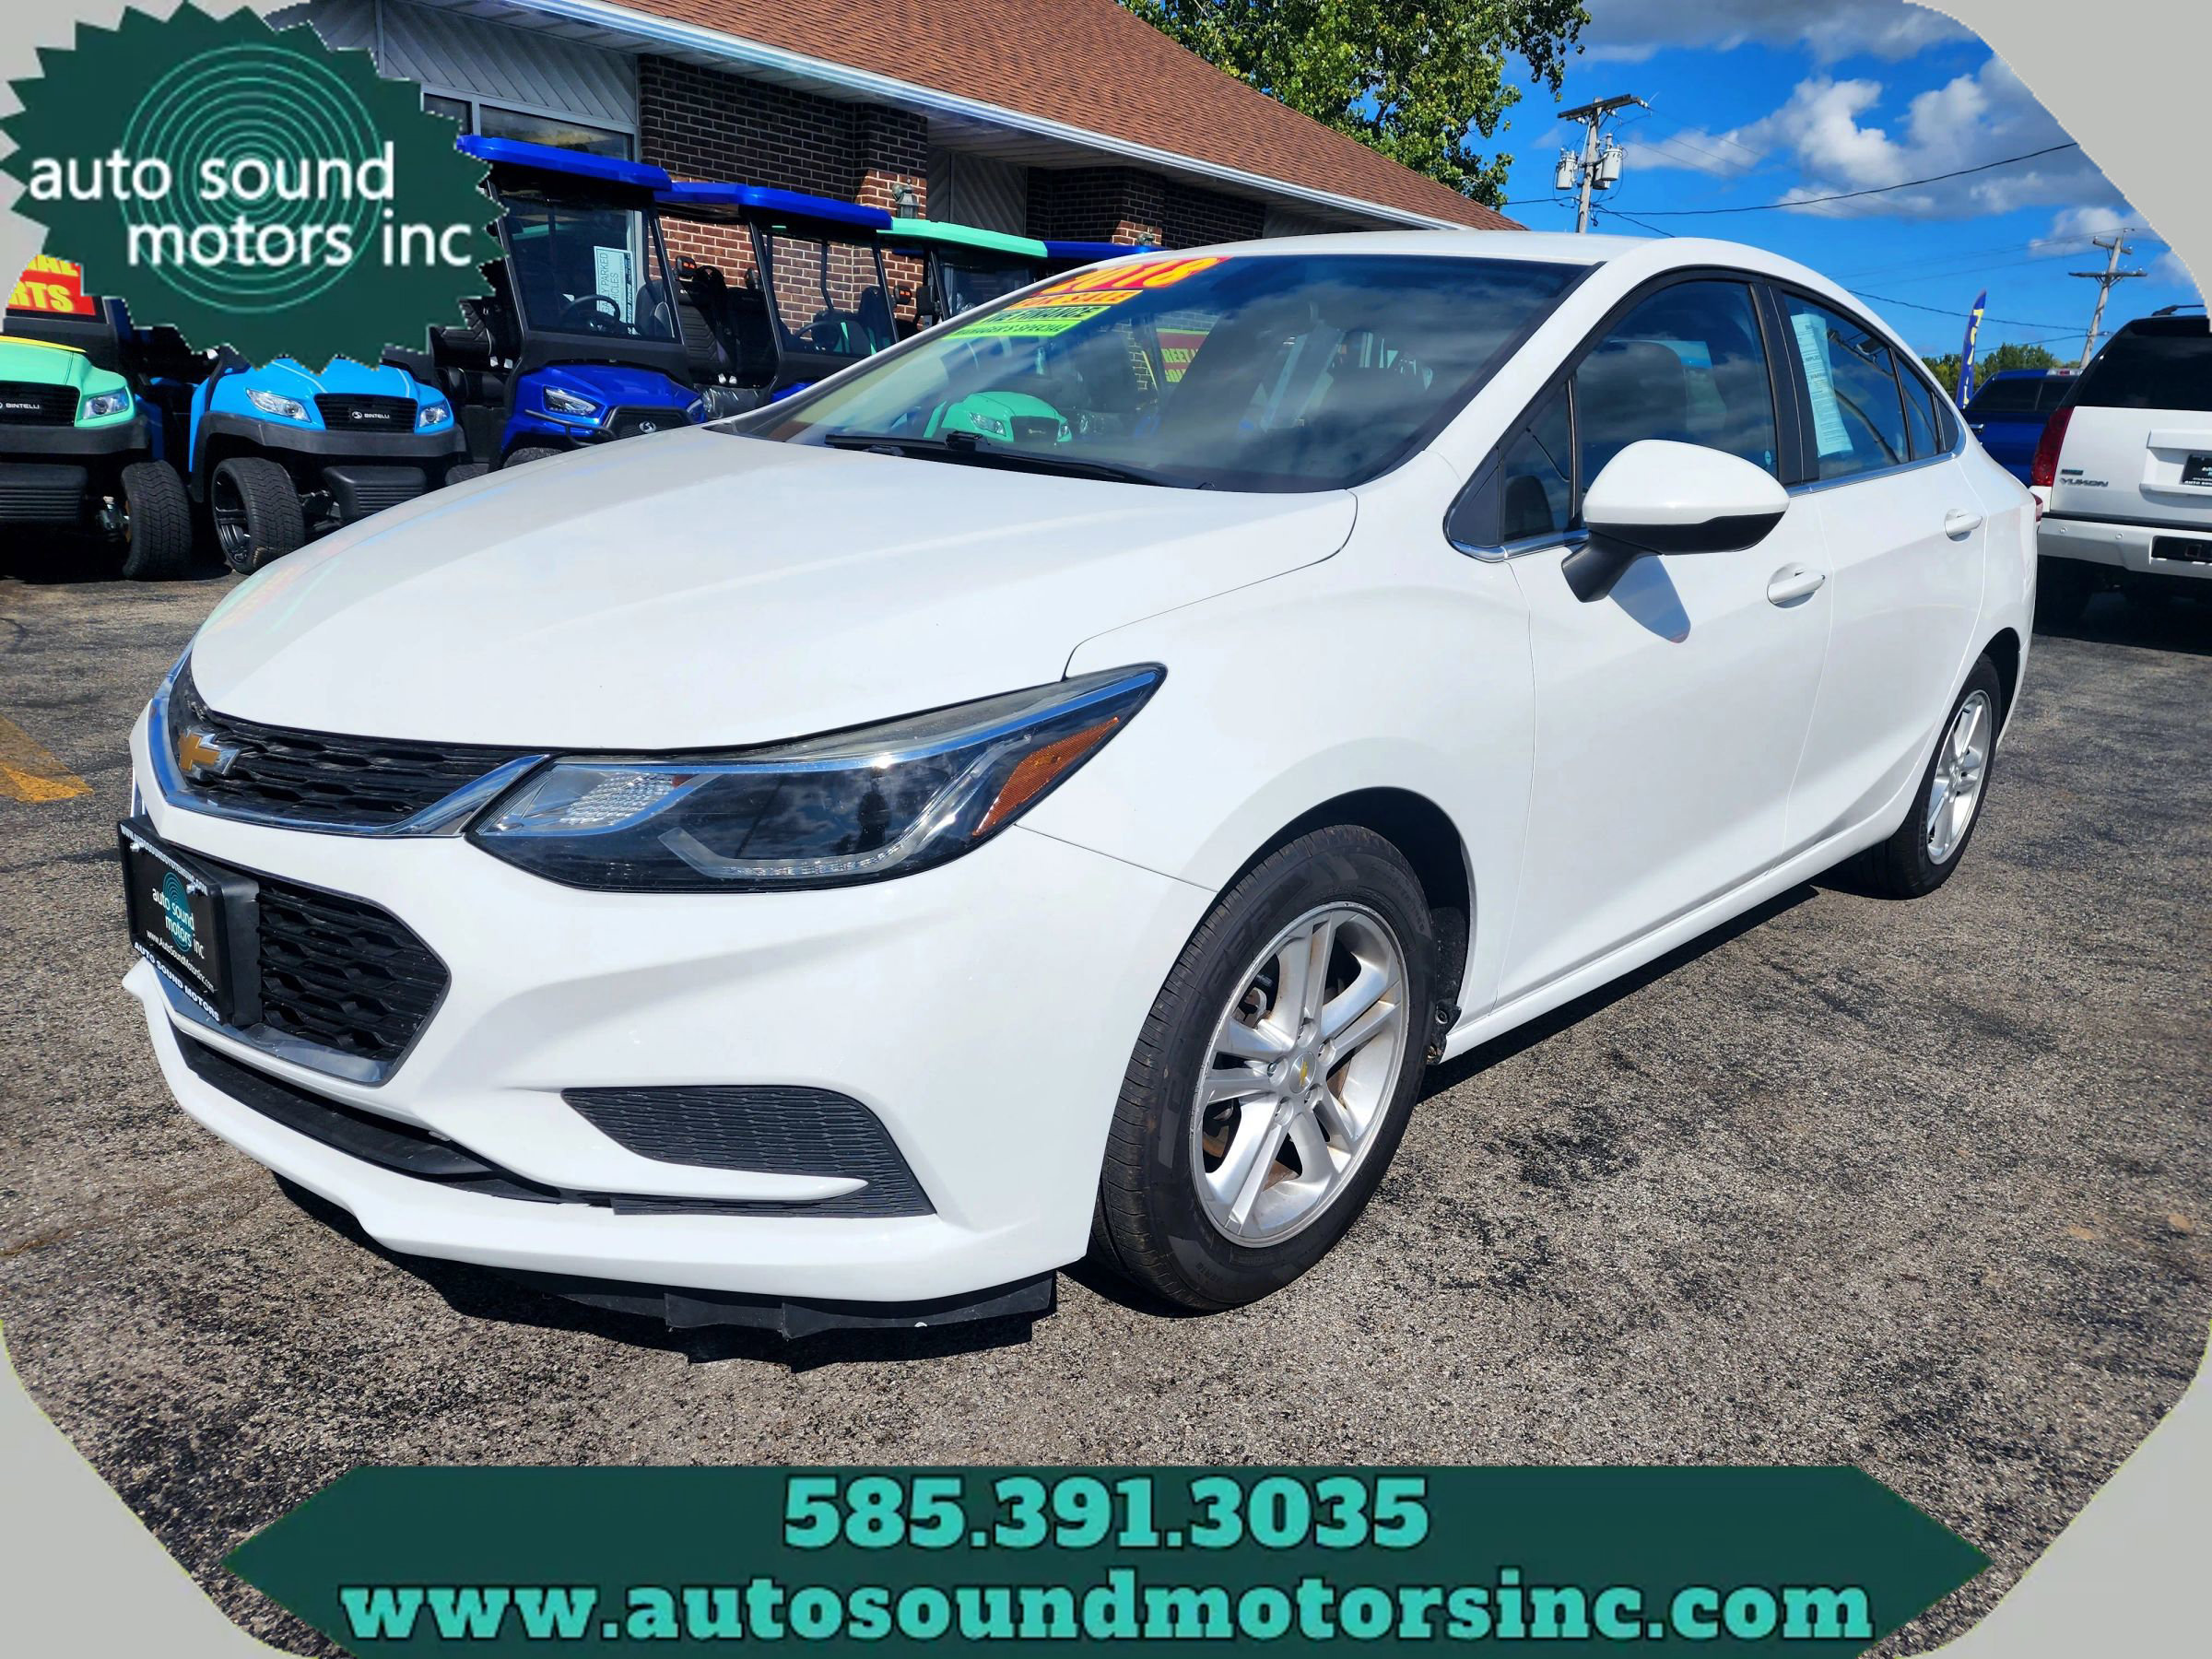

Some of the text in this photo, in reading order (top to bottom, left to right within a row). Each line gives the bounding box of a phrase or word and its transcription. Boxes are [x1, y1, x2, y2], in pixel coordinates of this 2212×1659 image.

[600, 253, 609, 286] PARKED
[1041, 257, 1218, 293] 2018
[2060, 477, 2109, 488] YUKON
[152, 888, 194, 931] auto sound
[165, 915, 205, 959] motors inc
[134, 941, 220, 1022] AUTO SOUND MOTORS
